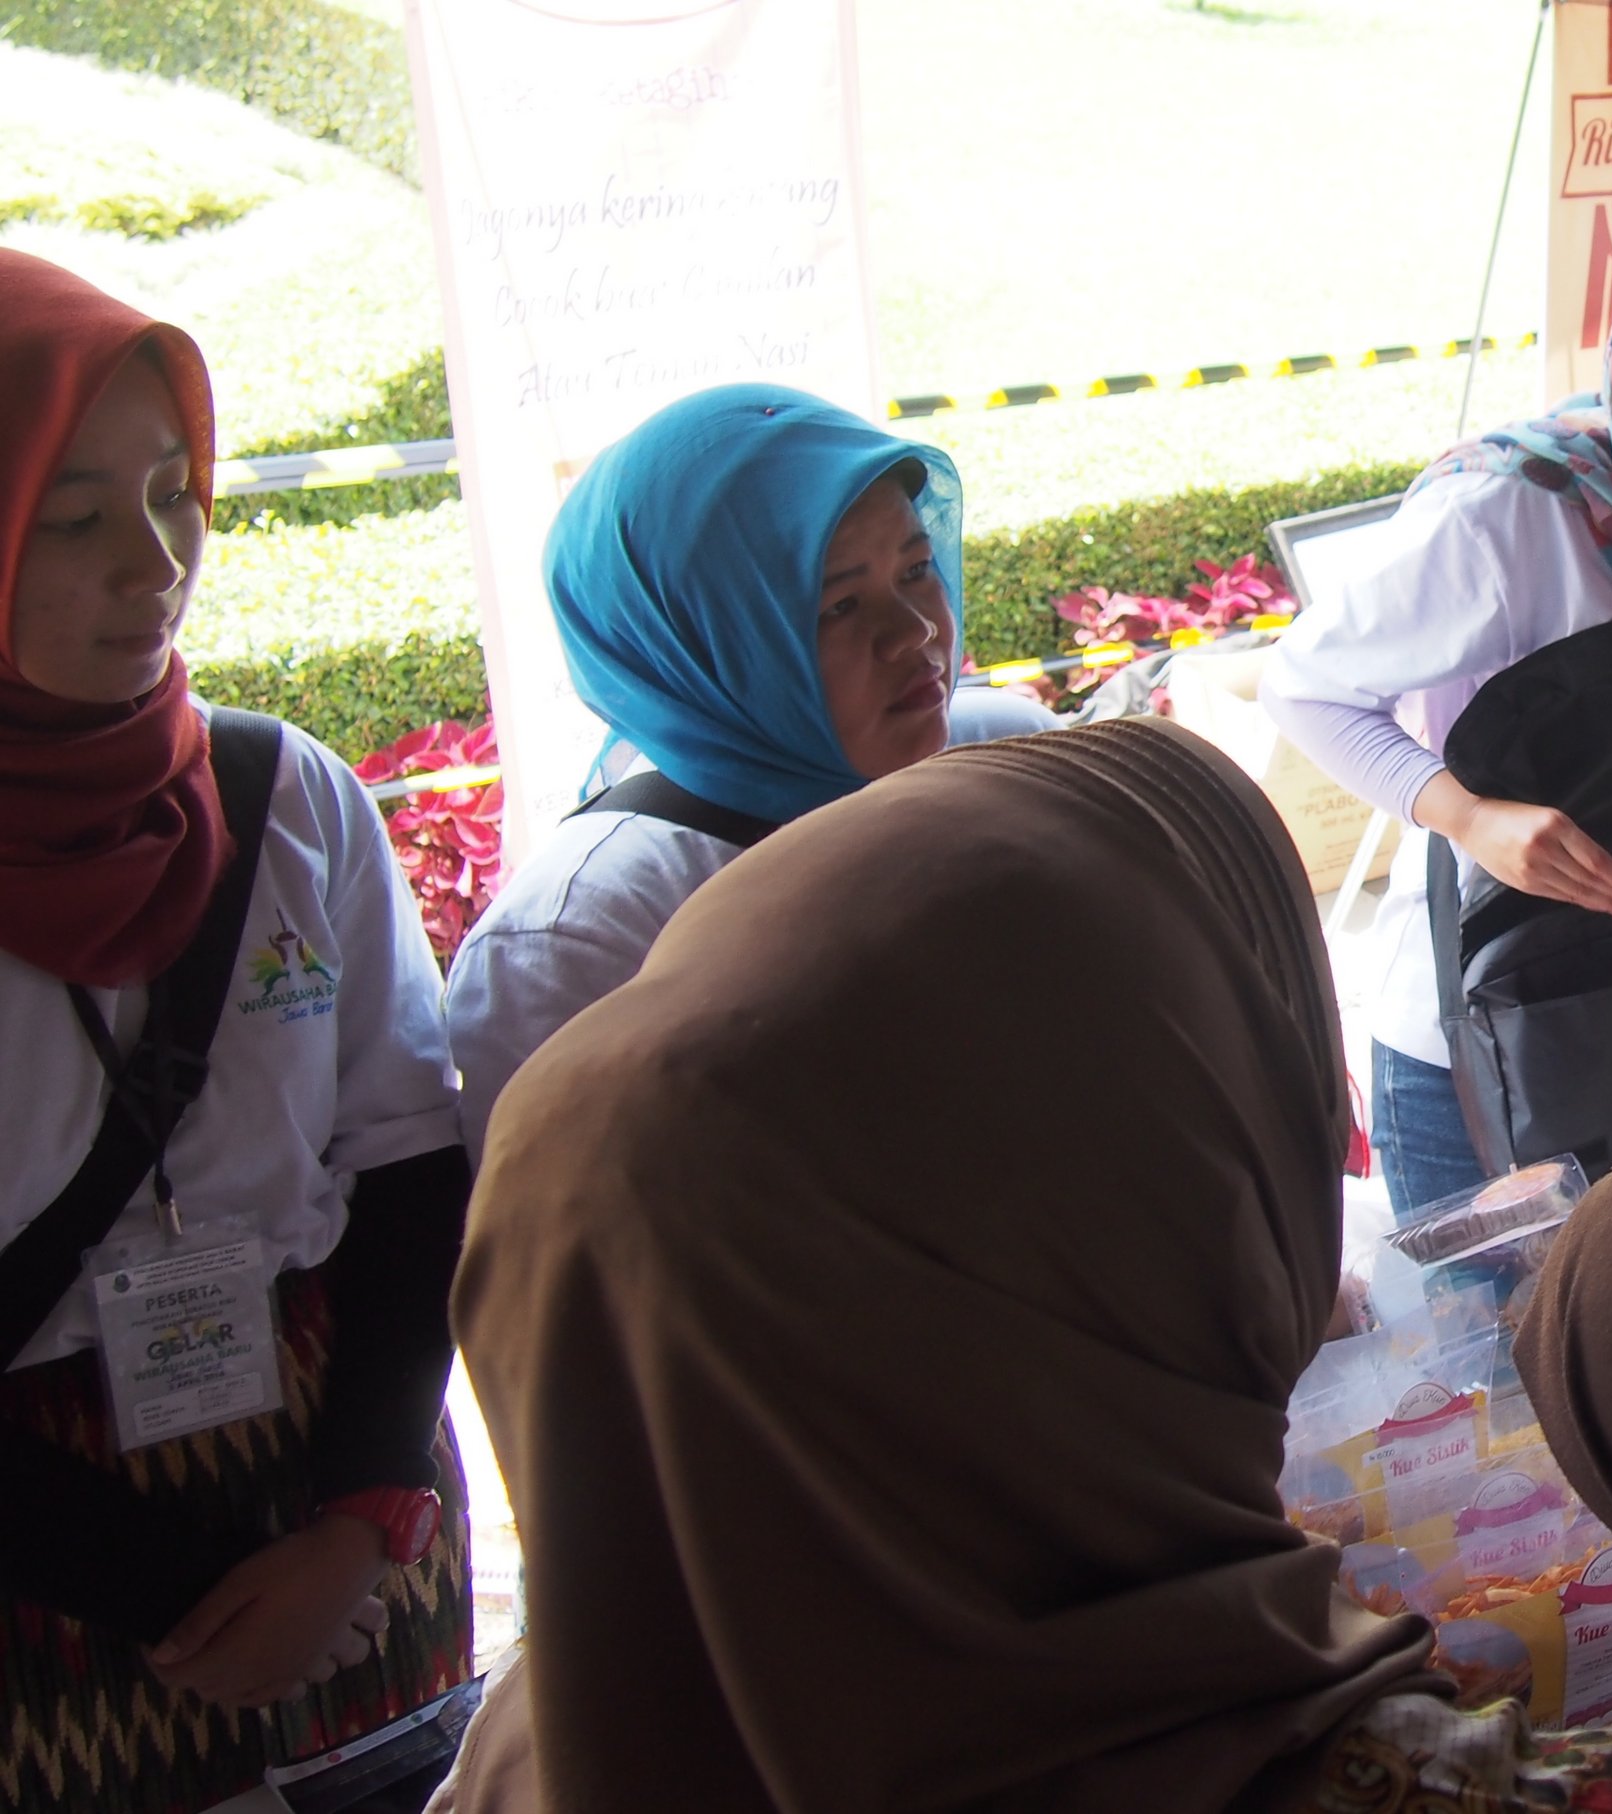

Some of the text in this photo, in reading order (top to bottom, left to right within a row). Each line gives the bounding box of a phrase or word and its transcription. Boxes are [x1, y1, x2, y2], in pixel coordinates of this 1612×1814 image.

[238, 986, 325, 1015] WIRAUSAHA
[145, 1283, 222, 1312] PESERTA
[146, 1322, 235, 1361] GELAR
[1389, 1437, 1471, 1478] Kue Sistik
[1573, 1624, 1611, 1646] Kue
